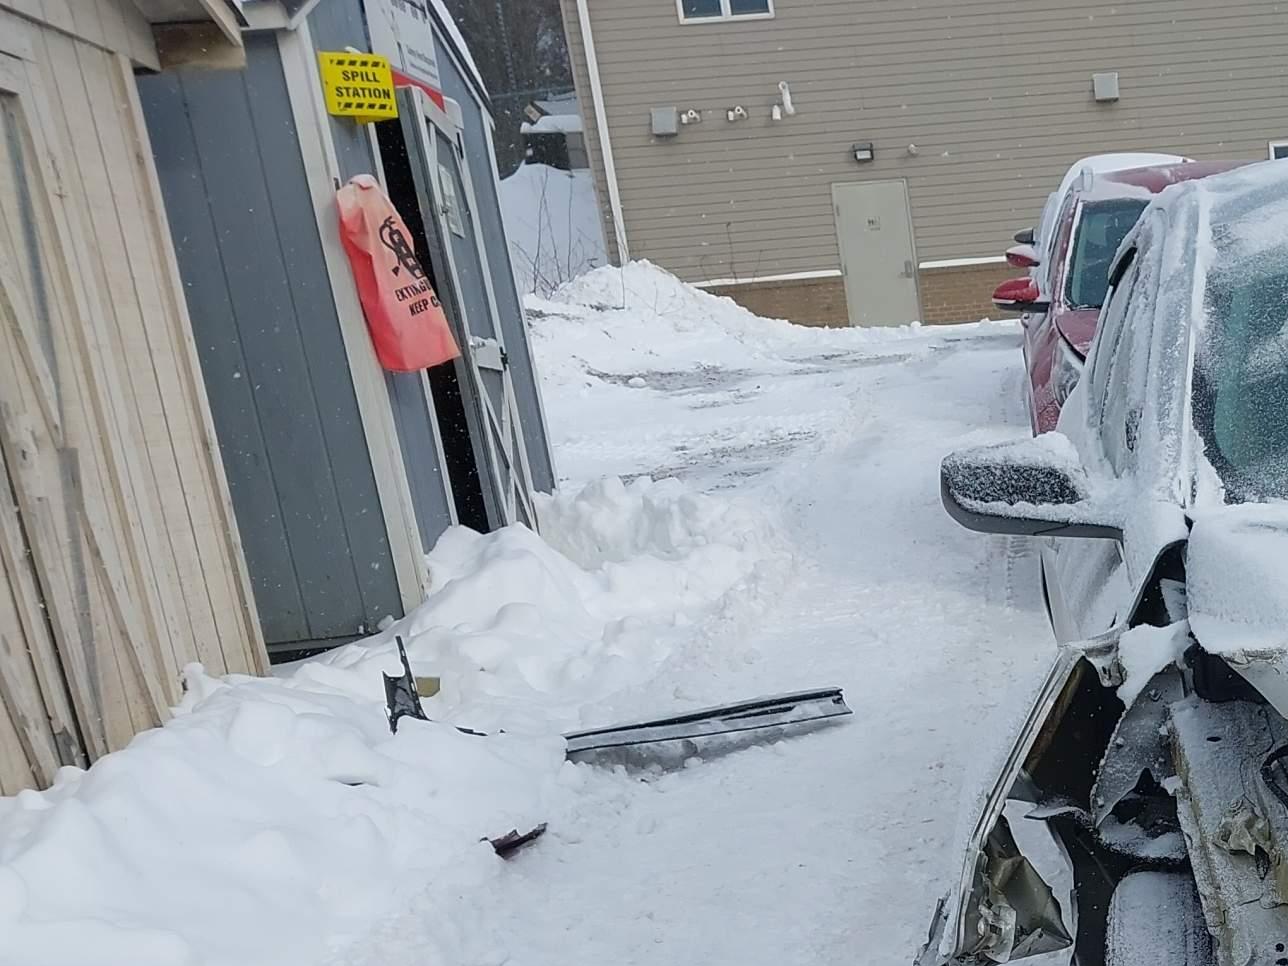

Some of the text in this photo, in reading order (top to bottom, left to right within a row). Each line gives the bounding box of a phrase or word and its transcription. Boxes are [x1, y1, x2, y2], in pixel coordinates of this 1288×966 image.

[342, 71, 380, 83] SPILL
[335, 86, 391, 99] STATION
[409, 299, 429, 316] KEEP
